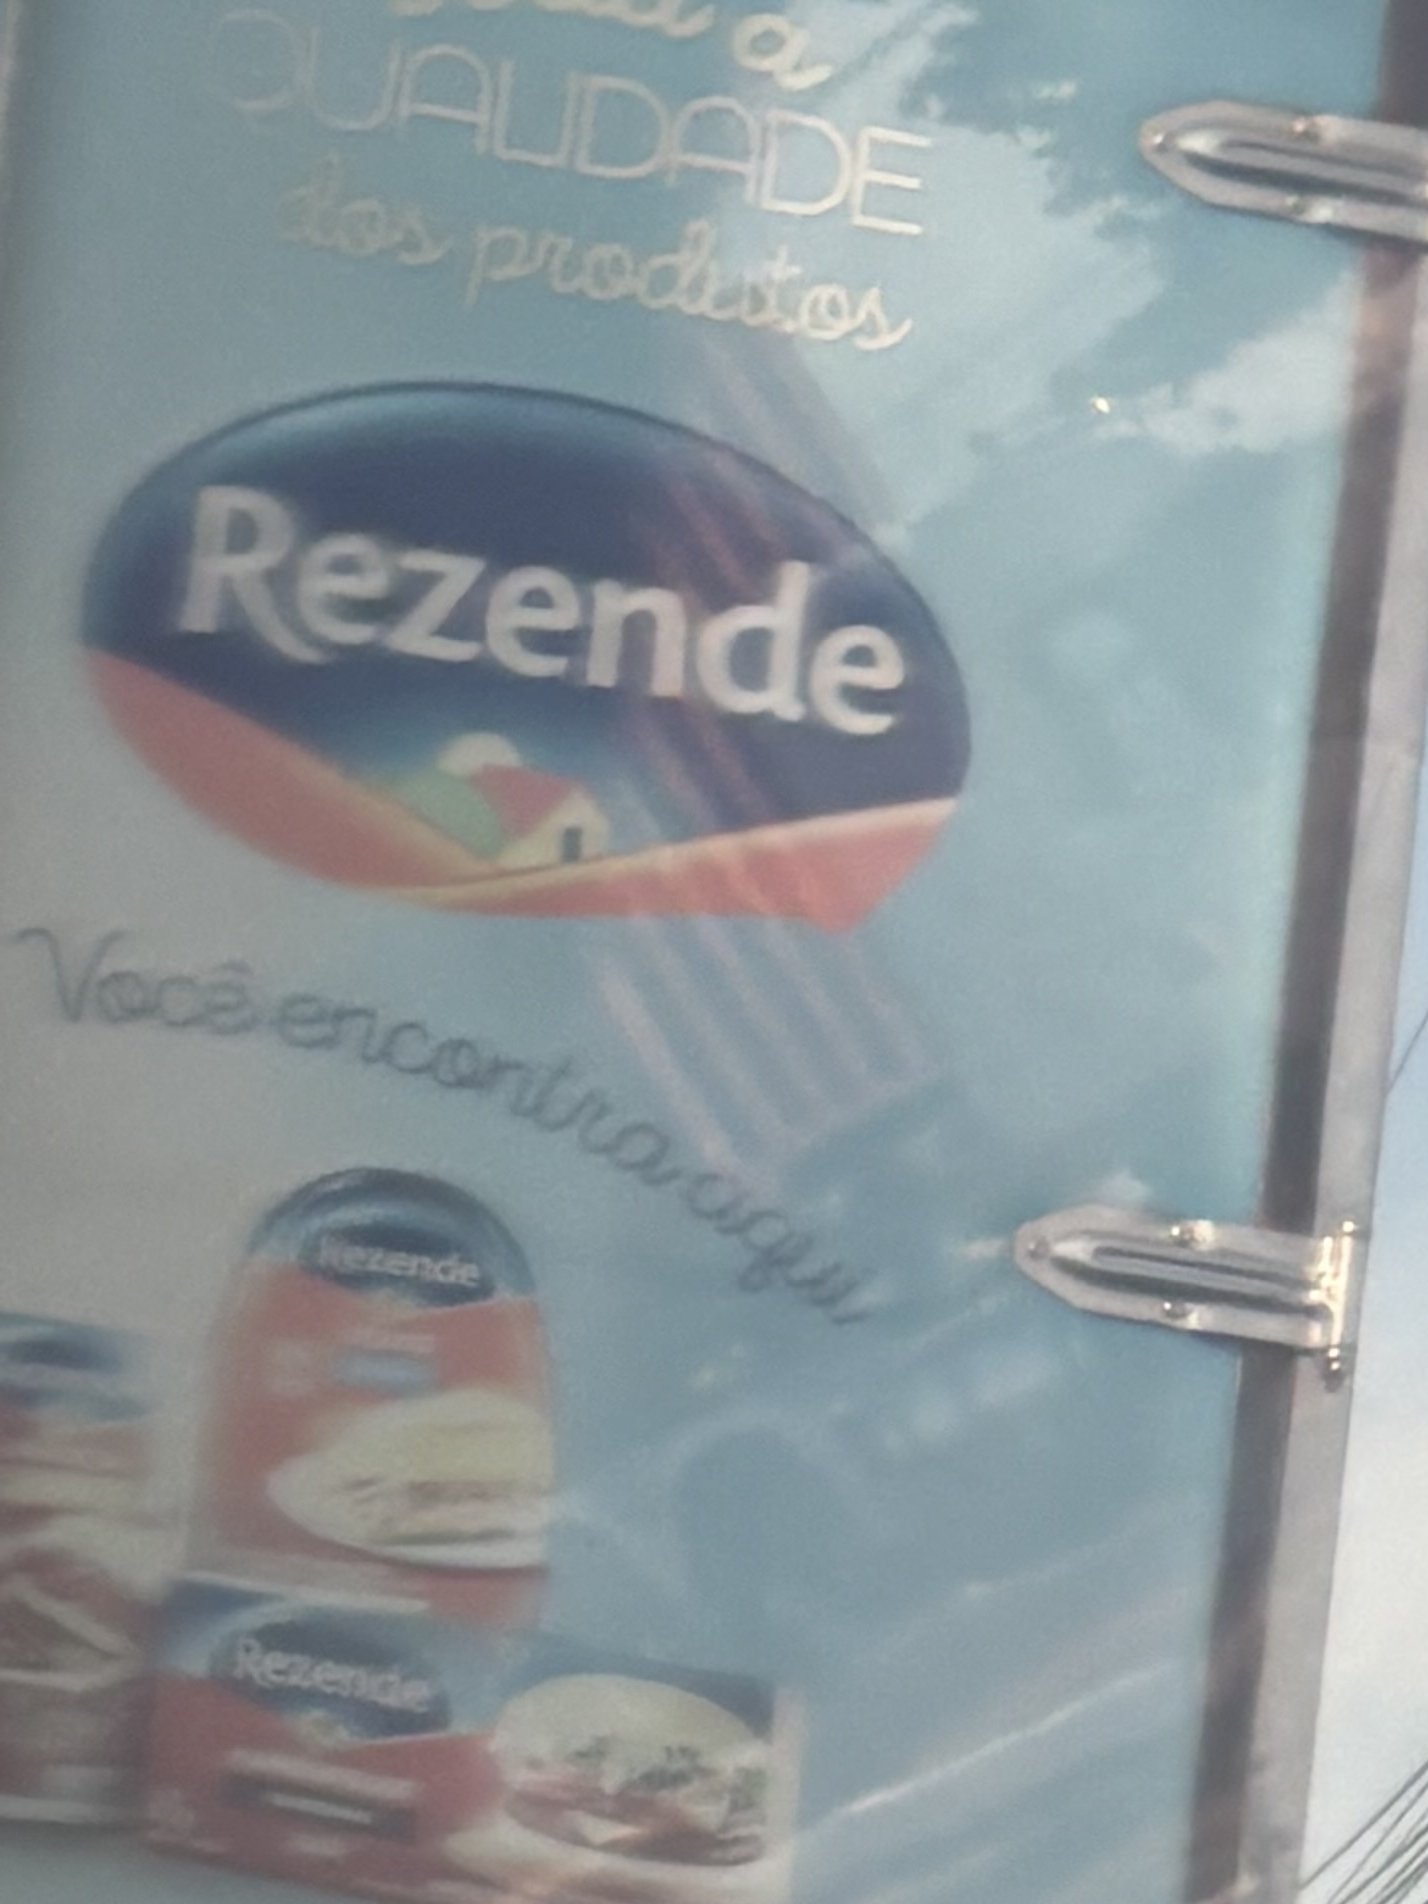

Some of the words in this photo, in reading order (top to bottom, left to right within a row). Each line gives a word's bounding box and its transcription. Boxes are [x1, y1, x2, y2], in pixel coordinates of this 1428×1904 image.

[464, 216, 913, 350] produtos
[178, 484, 907, 737] Rezende
[13, 926, 260, 1036] Você
